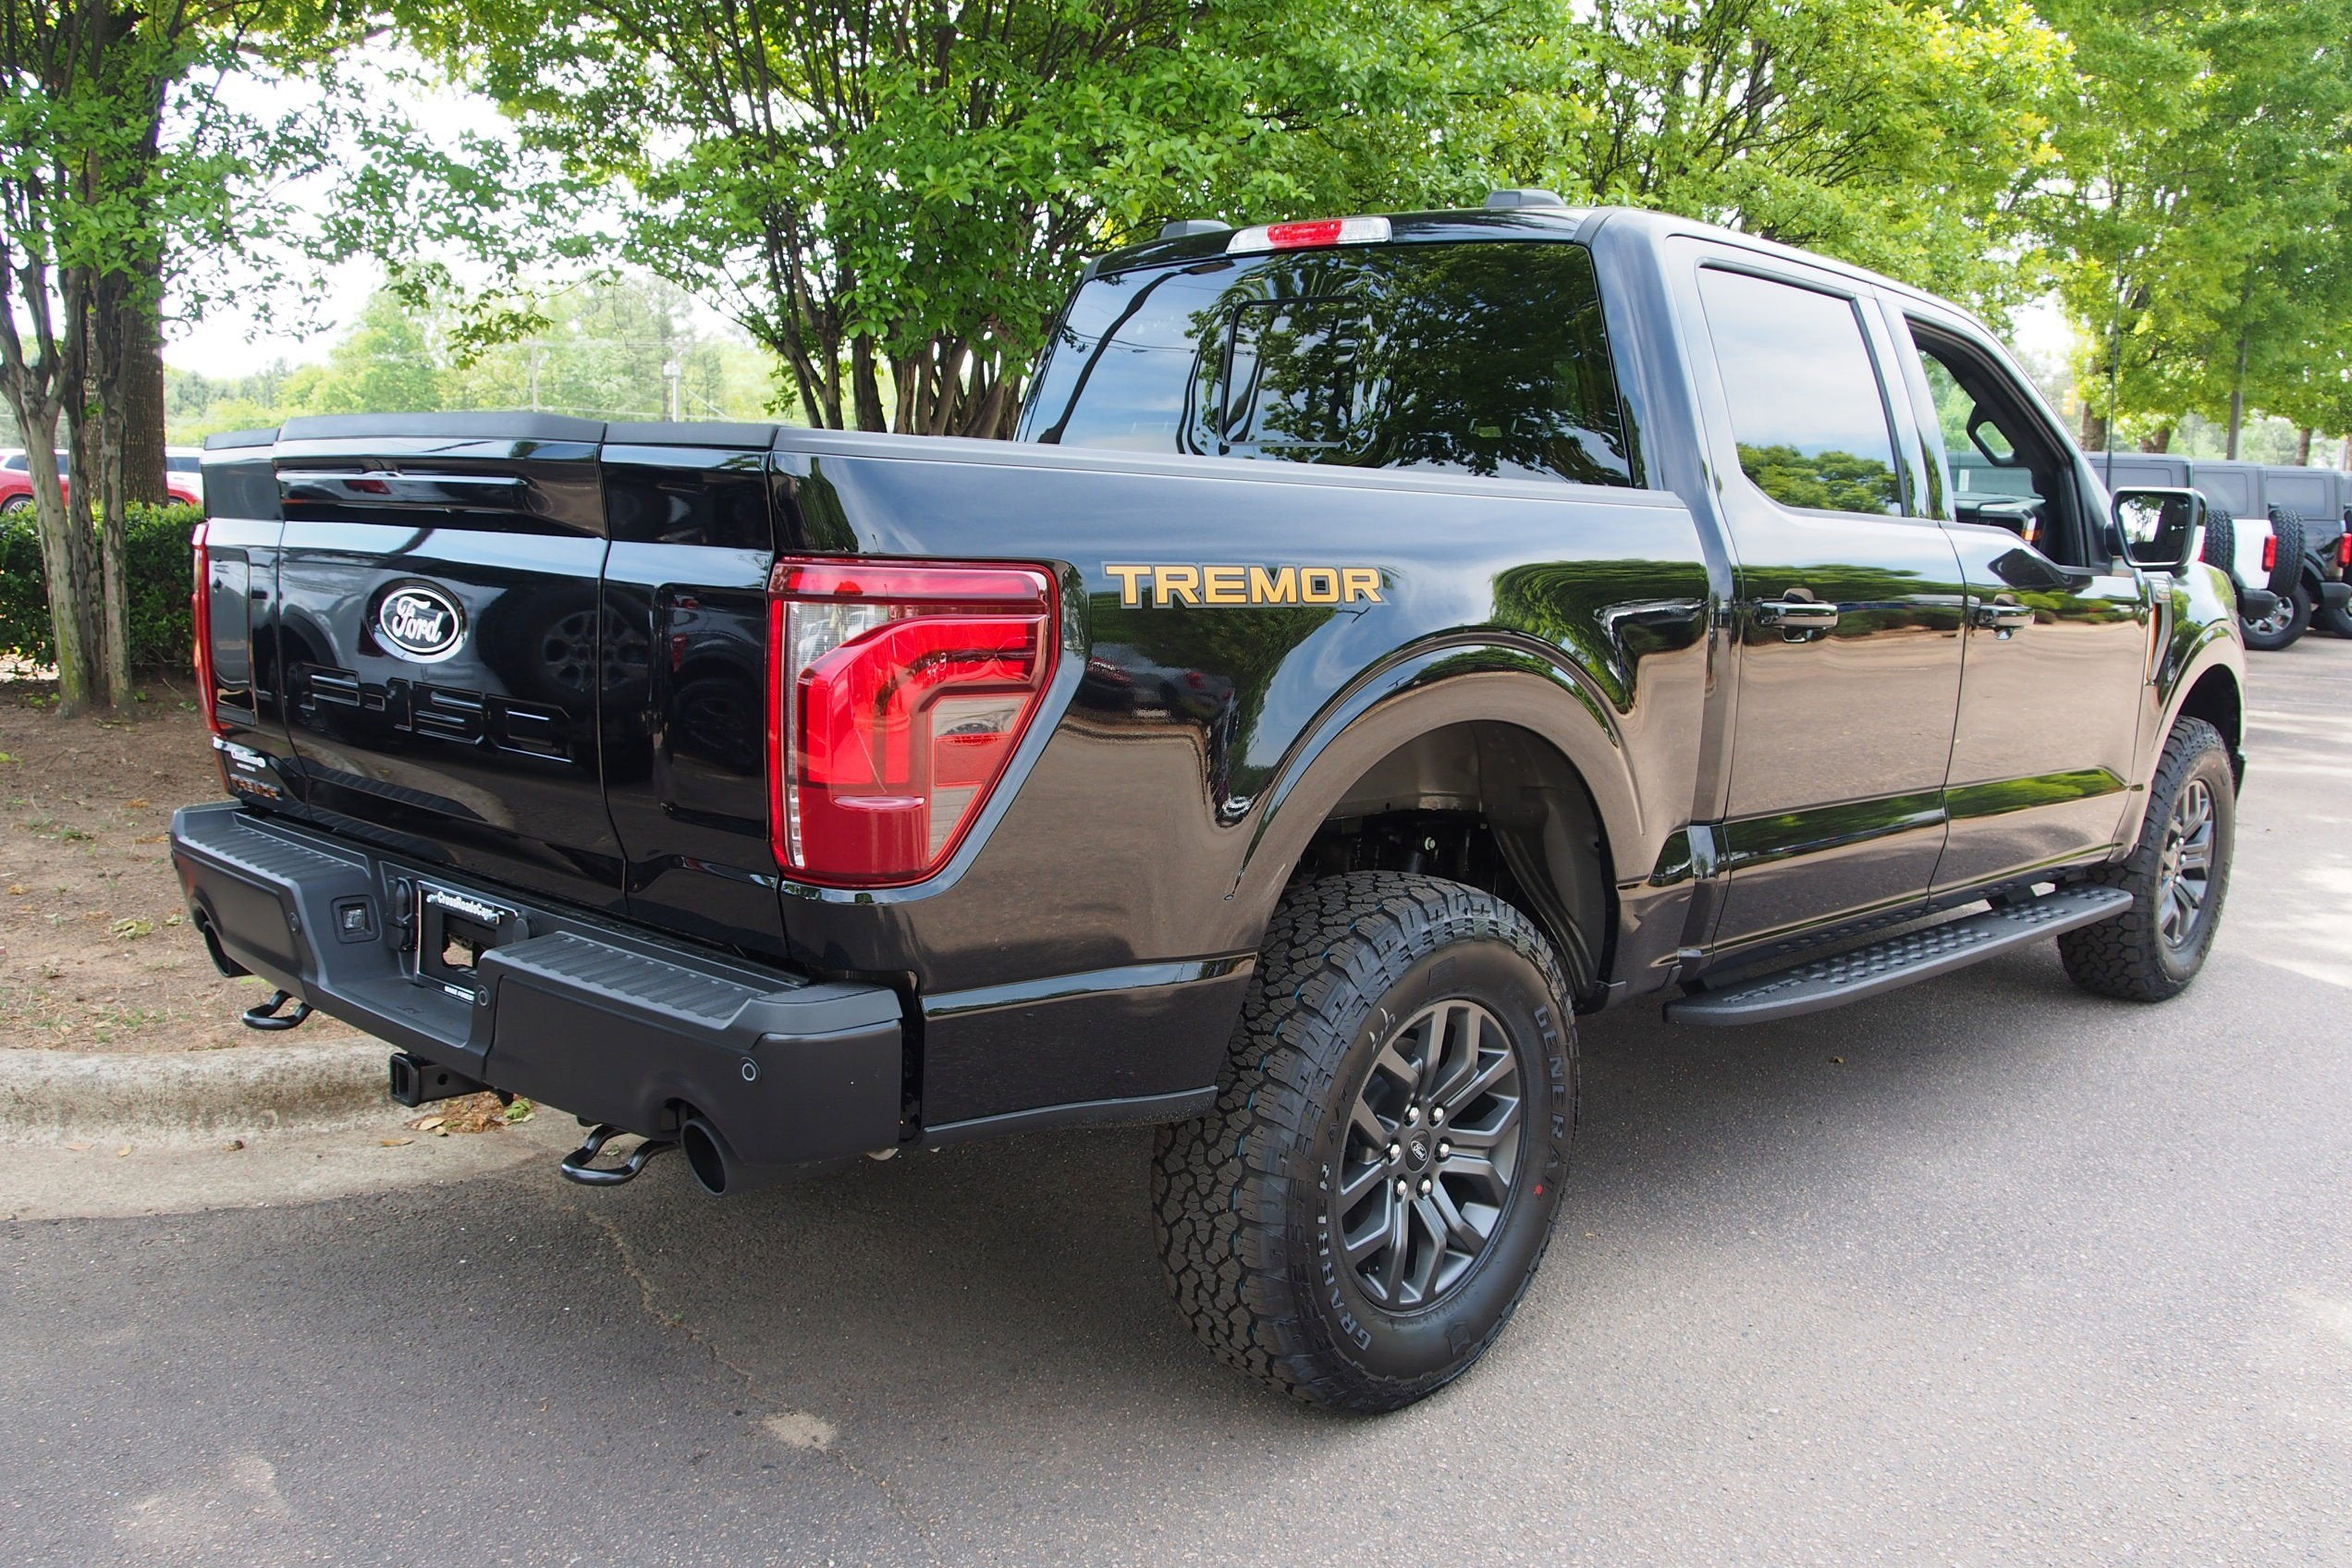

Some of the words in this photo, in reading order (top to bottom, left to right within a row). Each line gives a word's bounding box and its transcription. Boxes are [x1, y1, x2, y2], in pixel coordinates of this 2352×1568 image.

[391, 594, 444, 643] Ford
[1103, 562, 1388, 607] TREMOR
[298, 662, 572, 763] F-150
[1533, 1004, 1565, 1194] GENERAL
[1316, 1161, 1372, 1351] GRABBER
